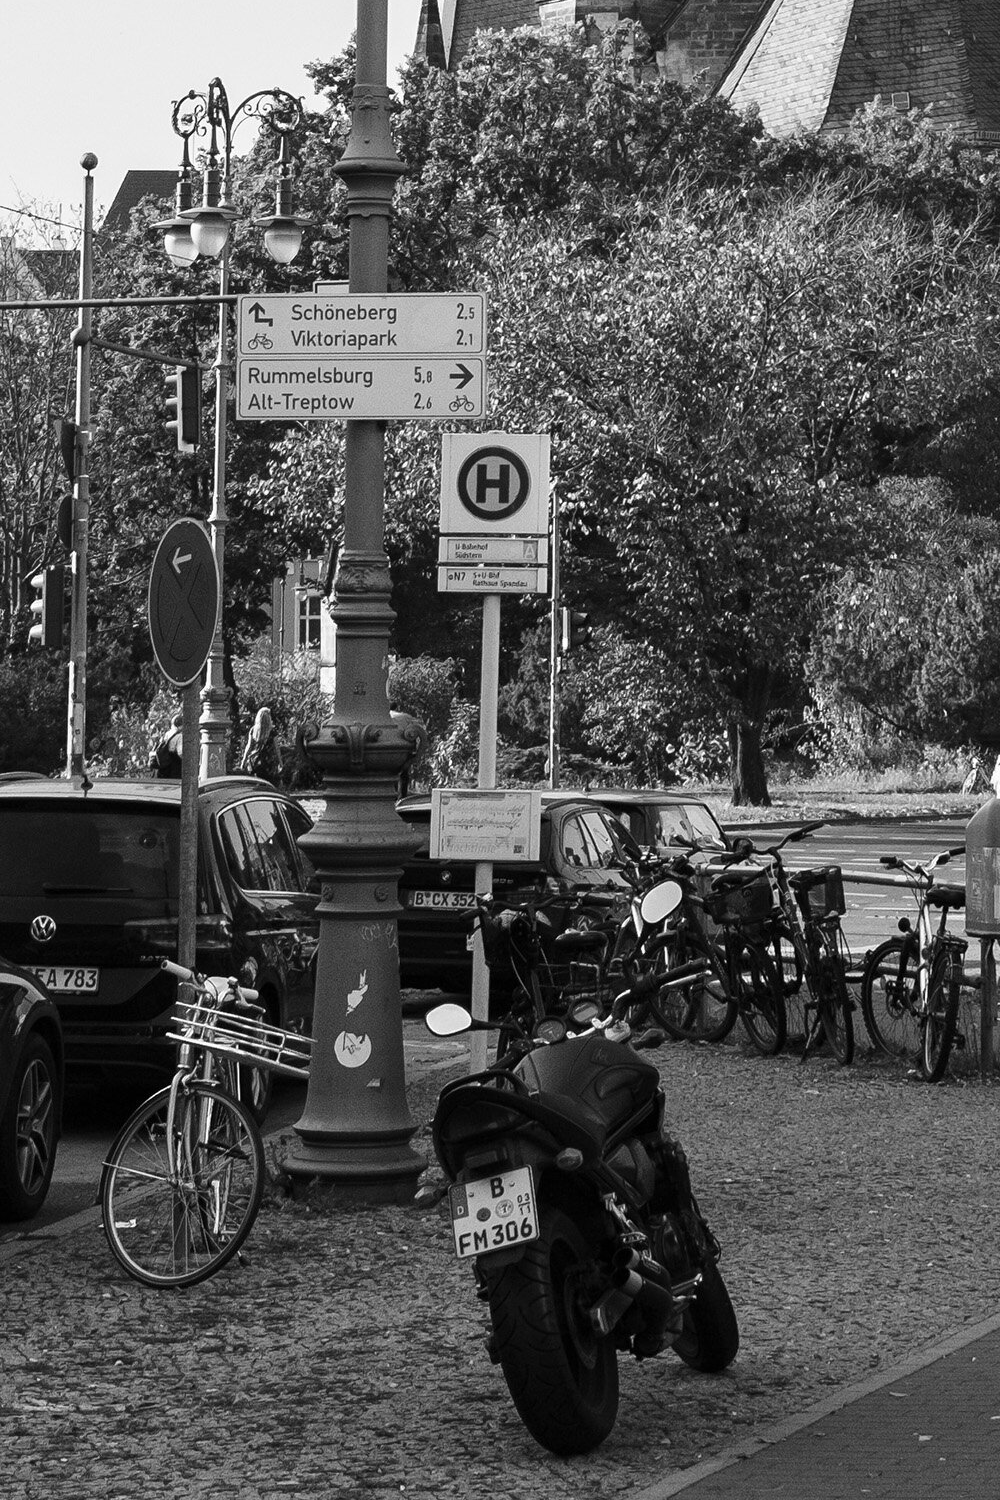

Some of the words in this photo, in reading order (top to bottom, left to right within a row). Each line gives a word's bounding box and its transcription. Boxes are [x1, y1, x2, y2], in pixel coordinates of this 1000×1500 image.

[290, 303, 397, 324] Schöneberg
[456, 302, 475, 320] 2,5
[290, 329, 397, 350] Viktoriapark
[456, 328, 473, 347] 2,1
[248, 366, 373, 388] Rummelsburg
[413, 366, 433, 384] 5,8
[248, 392, 354, 414] Alt-Treptow
[413, 392, 432, 410] 2,6
[476, 464, 510, 504] H
[415, 892, 424, 905] B
[433, 893, 449, 906] CX
[451, 893, 475, 907] 352
[63, 969, 97, 988] 783
[490, 1178, 504, 1198] B
[459, 1229, 488, 1255] FM
[492, 1217, 533, 1246] 306
